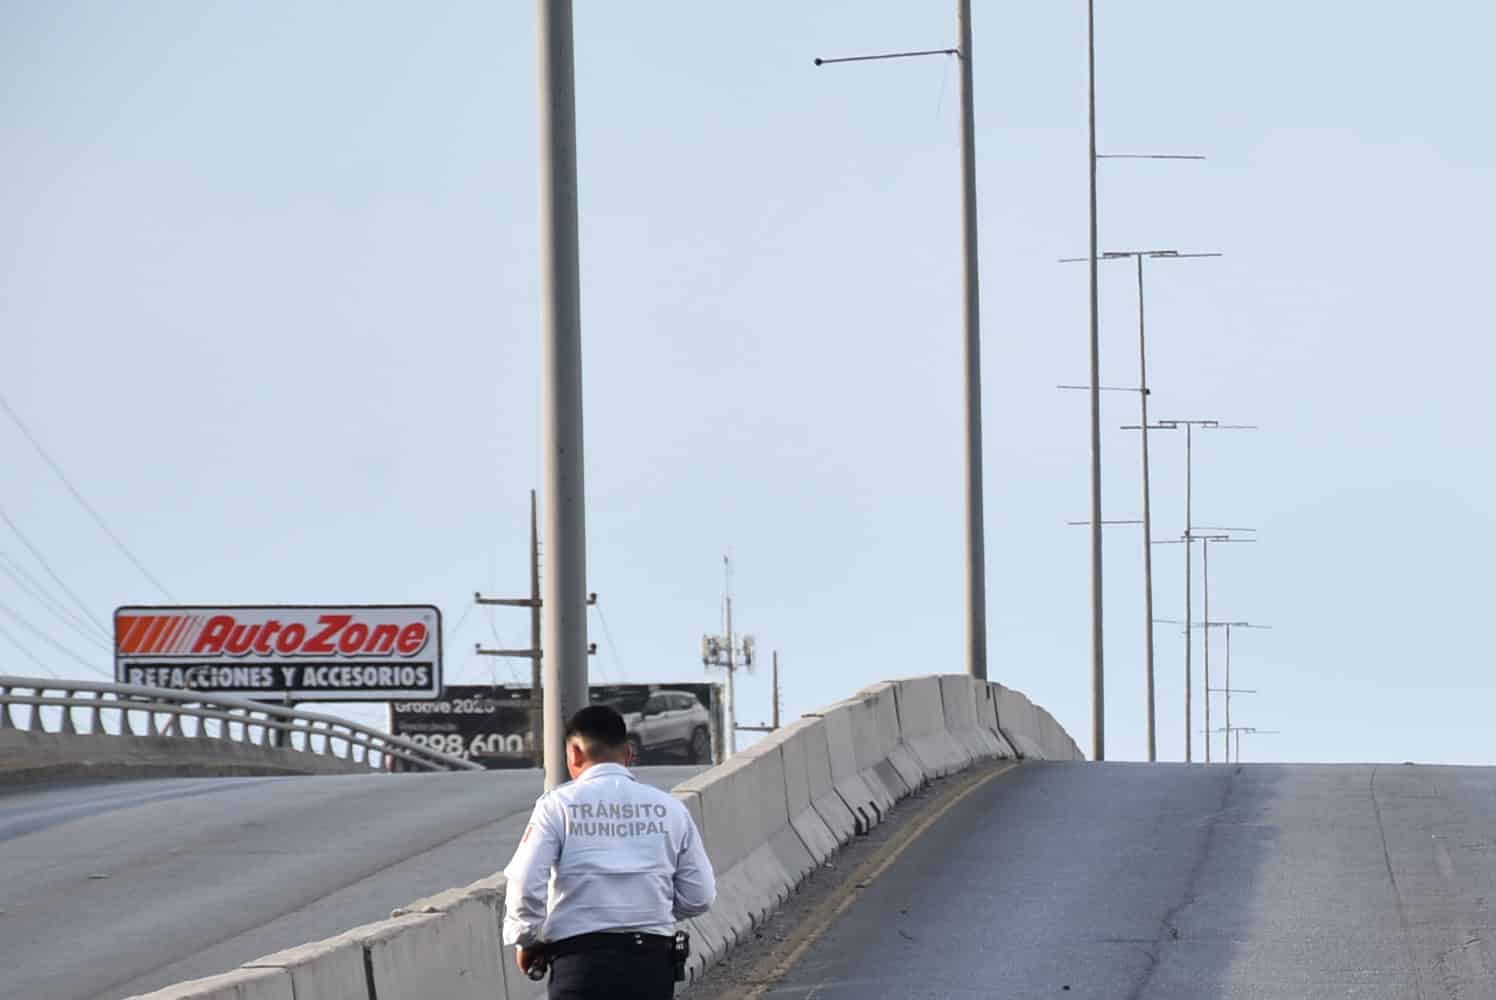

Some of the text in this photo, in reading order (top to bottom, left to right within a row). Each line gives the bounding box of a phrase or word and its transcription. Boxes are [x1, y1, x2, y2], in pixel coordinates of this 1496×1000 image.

[191, 613, 428, 657] AutoZone
[281, 666, 297, 687] Y
[302, 666, 428, 687] ACCESORIOS
[567, 799, 667, 819] TRÁNSITO
[568, 821, 669, 838] MUNICIPAL
